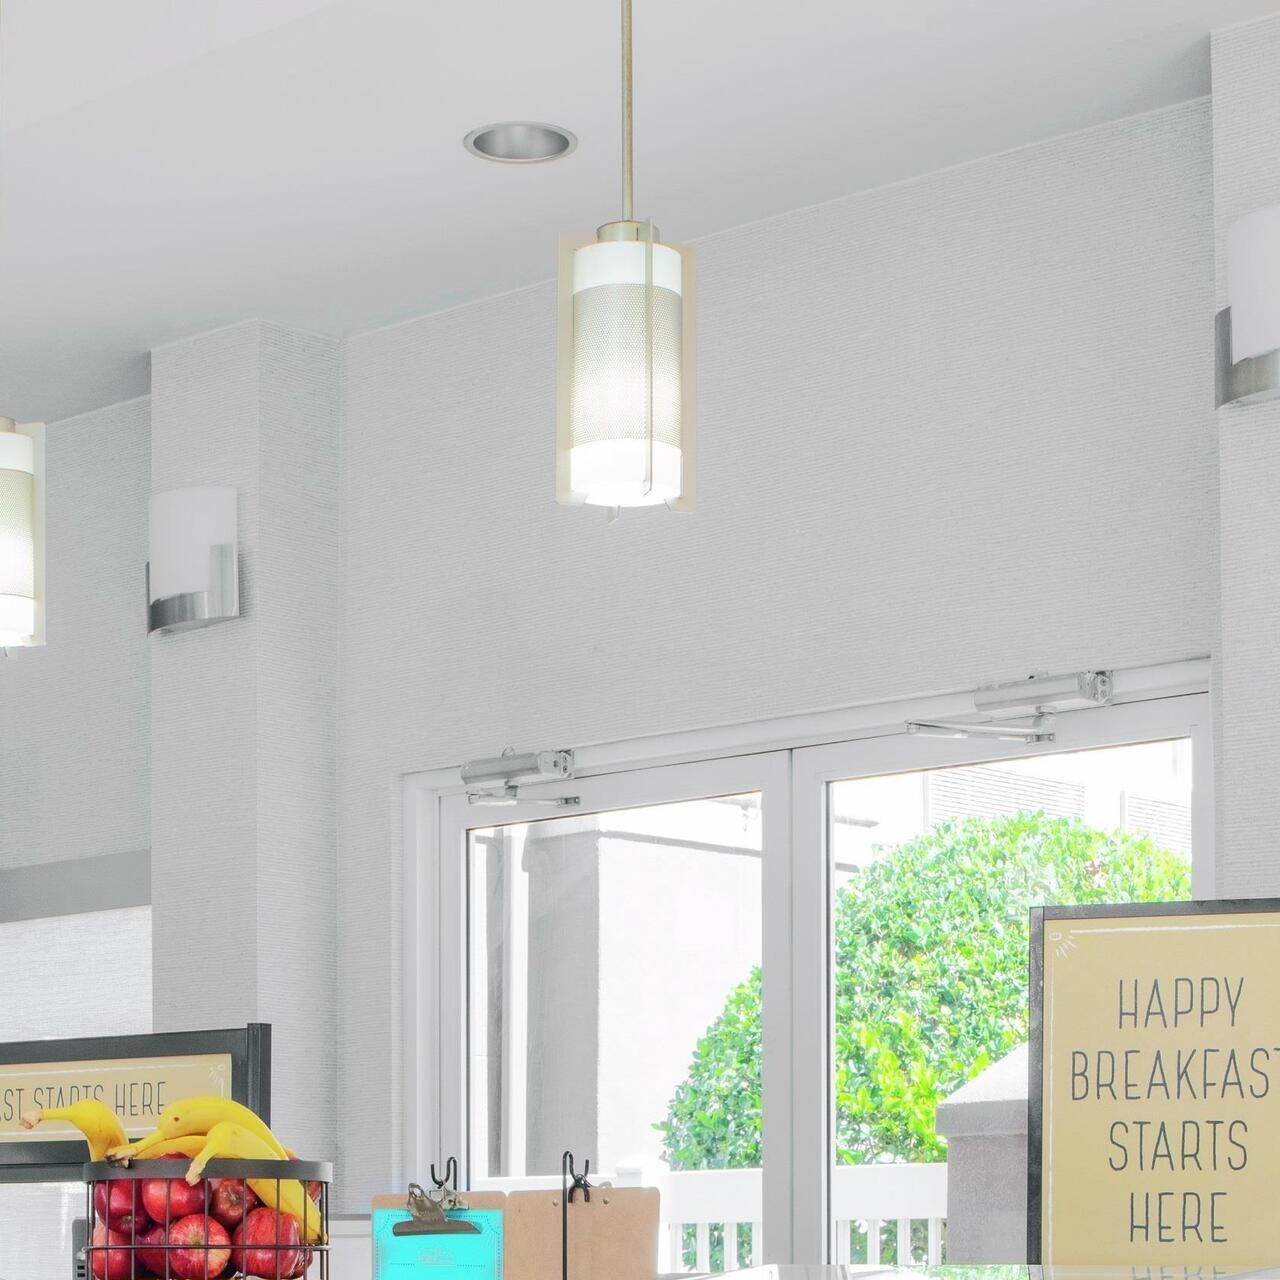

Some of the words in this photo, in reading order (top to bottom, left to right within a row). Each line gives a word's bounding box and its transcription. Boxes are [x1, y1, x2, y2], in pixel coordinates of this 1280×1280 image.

[1118, 976, 1244, 1030] HAPPY
[115, 1081, 166, 1117] HERE
[1108, 1119, 1248, 1172] STARTS
[1129, 1191, 1228, 1243] HERE
